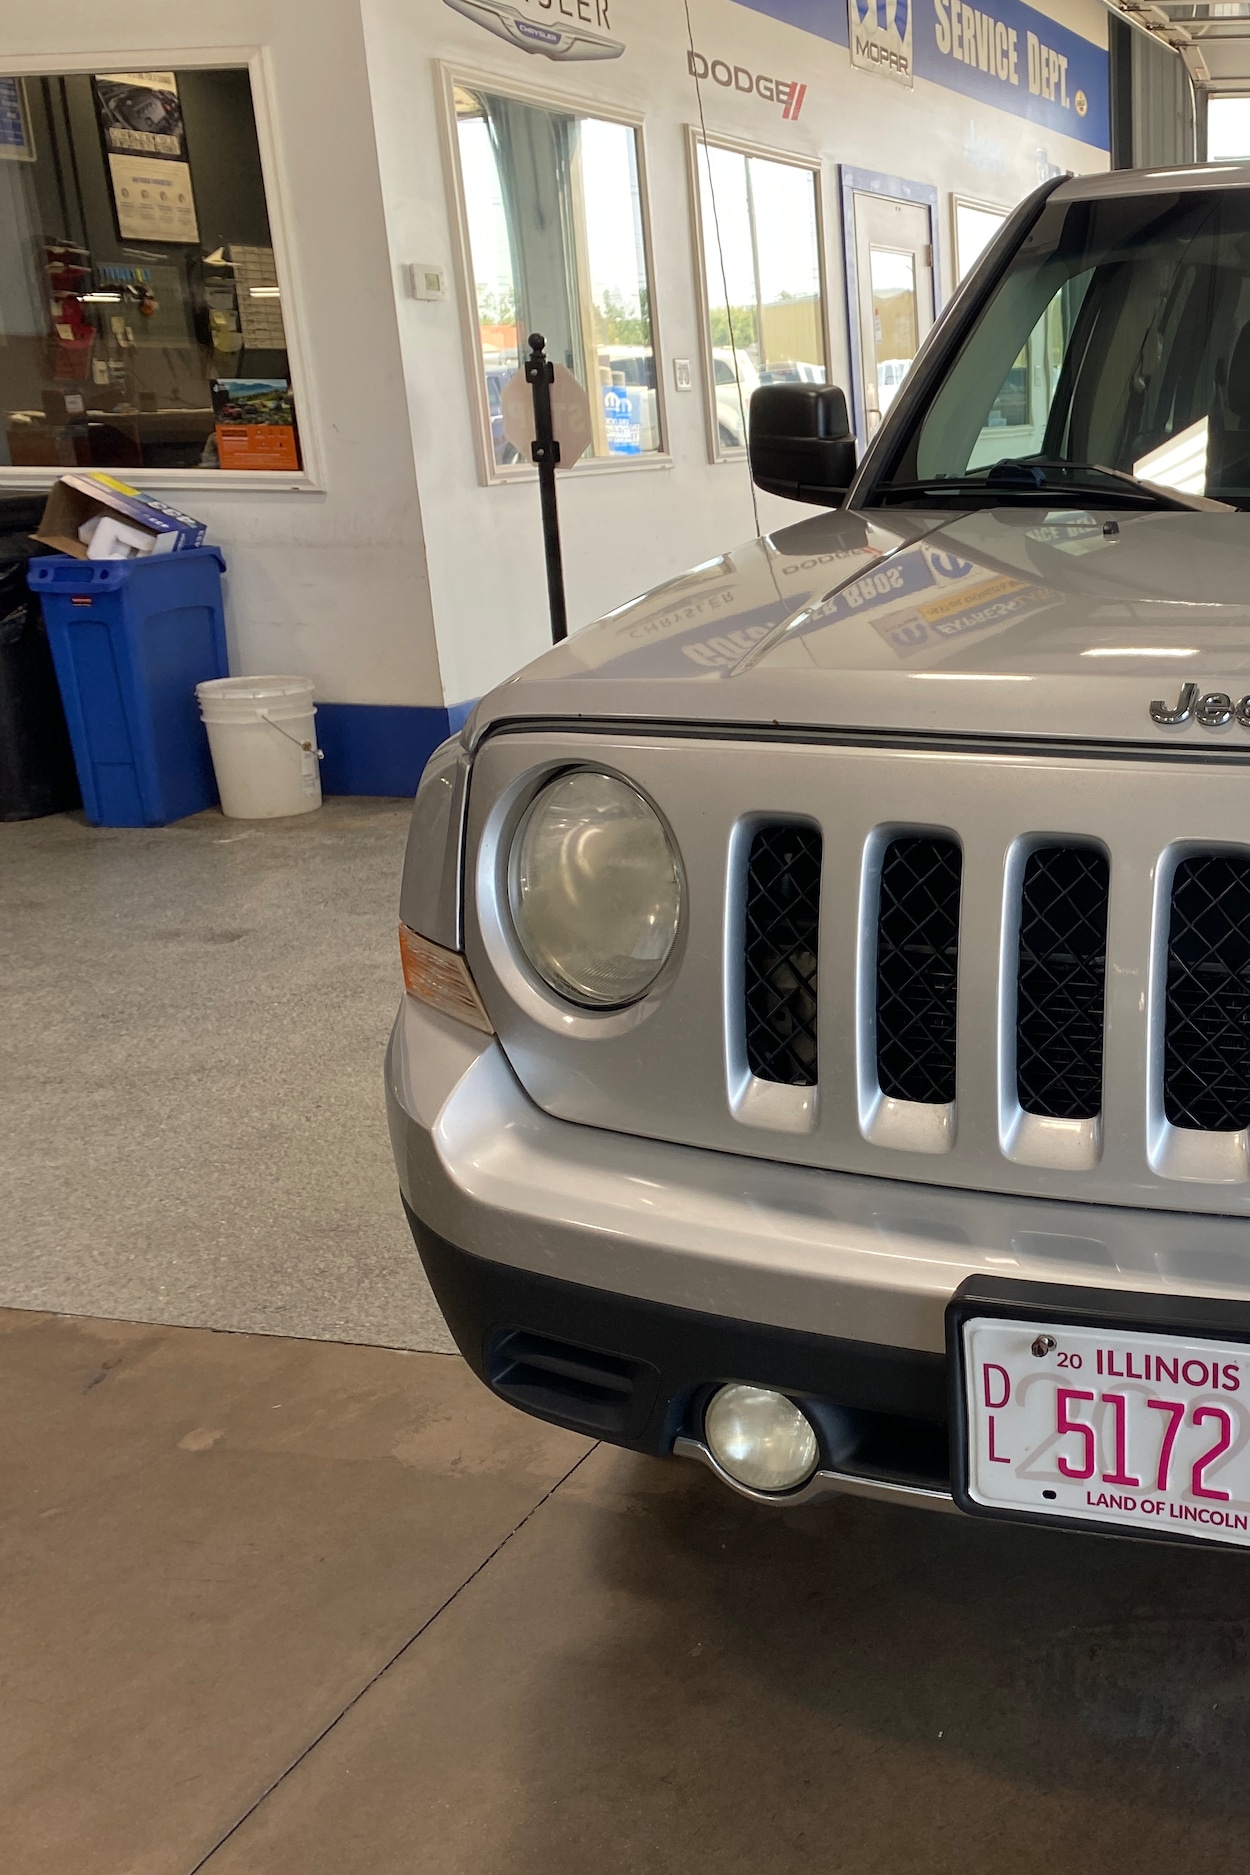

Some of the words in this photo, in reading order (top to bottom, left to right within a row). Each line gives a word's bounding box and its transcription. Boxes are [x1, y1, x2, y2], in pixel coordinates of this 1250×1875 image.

[687, 49, 792, 105] DODGE
[856, 36, 909, 78] MOPAR
[935, 0, 1018, 85] SERVICE
[1027, 31, 1070, 108] DEPT.
[1057, 1352, 1082, 1369] 20
[1096, 1350, 1240, 1391] ILLINOIS
[1056, 1388, 1230, 1501] 5172
[1086, 1491, 1137, 1511] LAND
[1140, 1499, 1167, 1516] OF
[1169, 1503, 1249, 1531] LINCOLN
